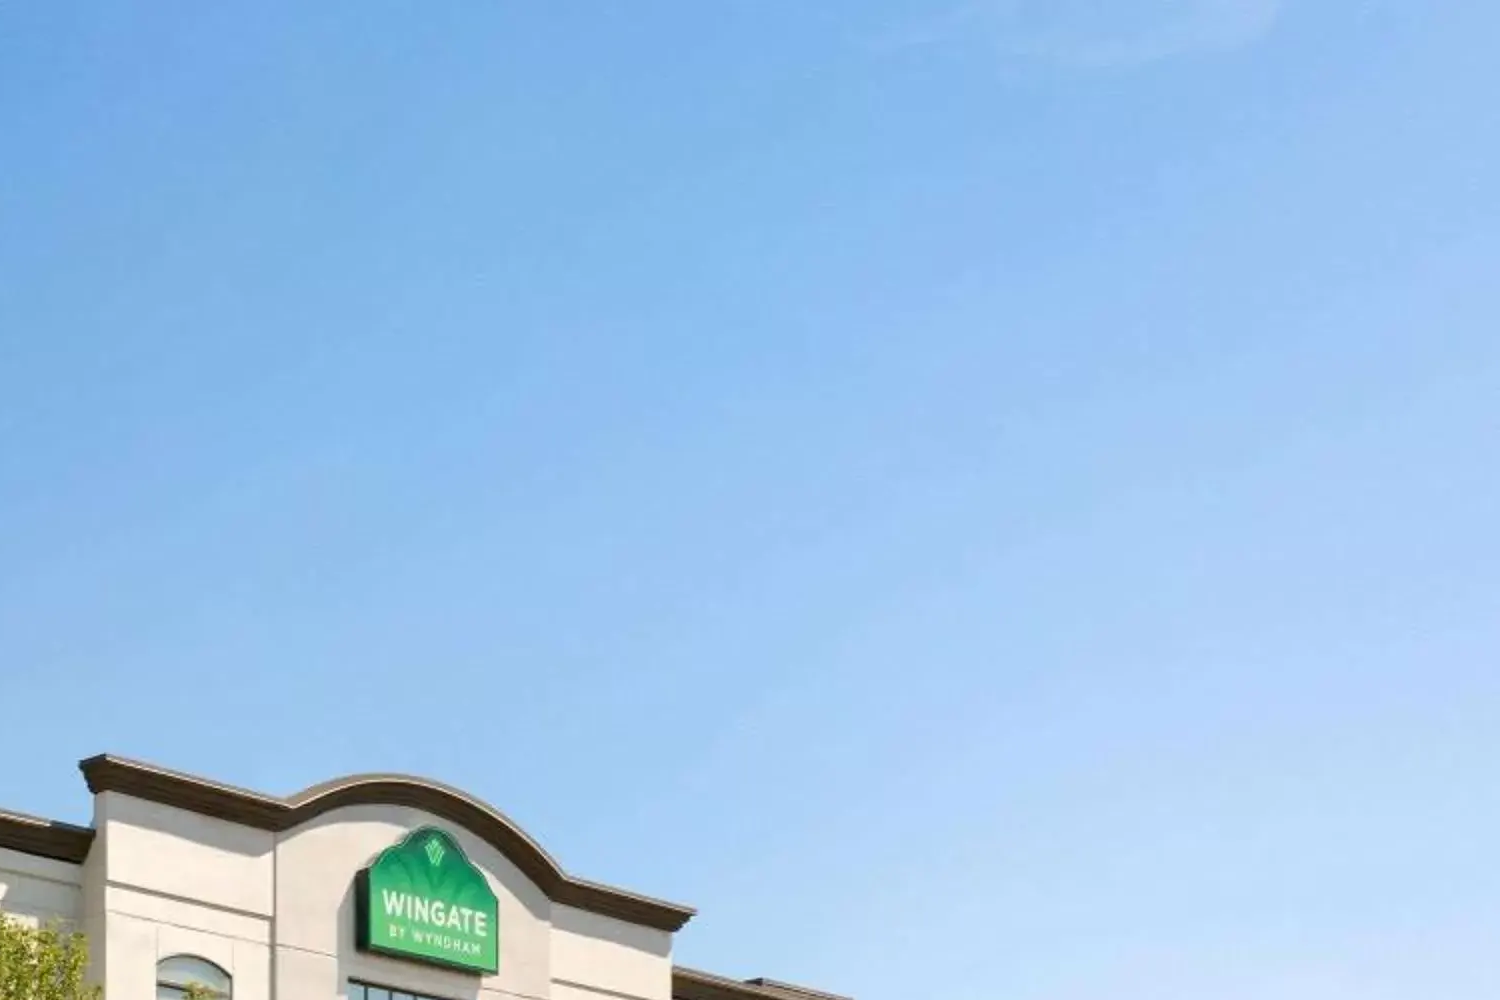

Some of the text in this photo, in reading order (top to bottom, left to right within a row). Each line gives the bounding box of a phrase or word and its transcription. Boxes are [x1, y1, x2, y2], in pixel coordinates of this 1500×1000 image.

[382, 889, 488, 937] WINGATE
[389, 924, 482, 955] BY WYNDHAM
